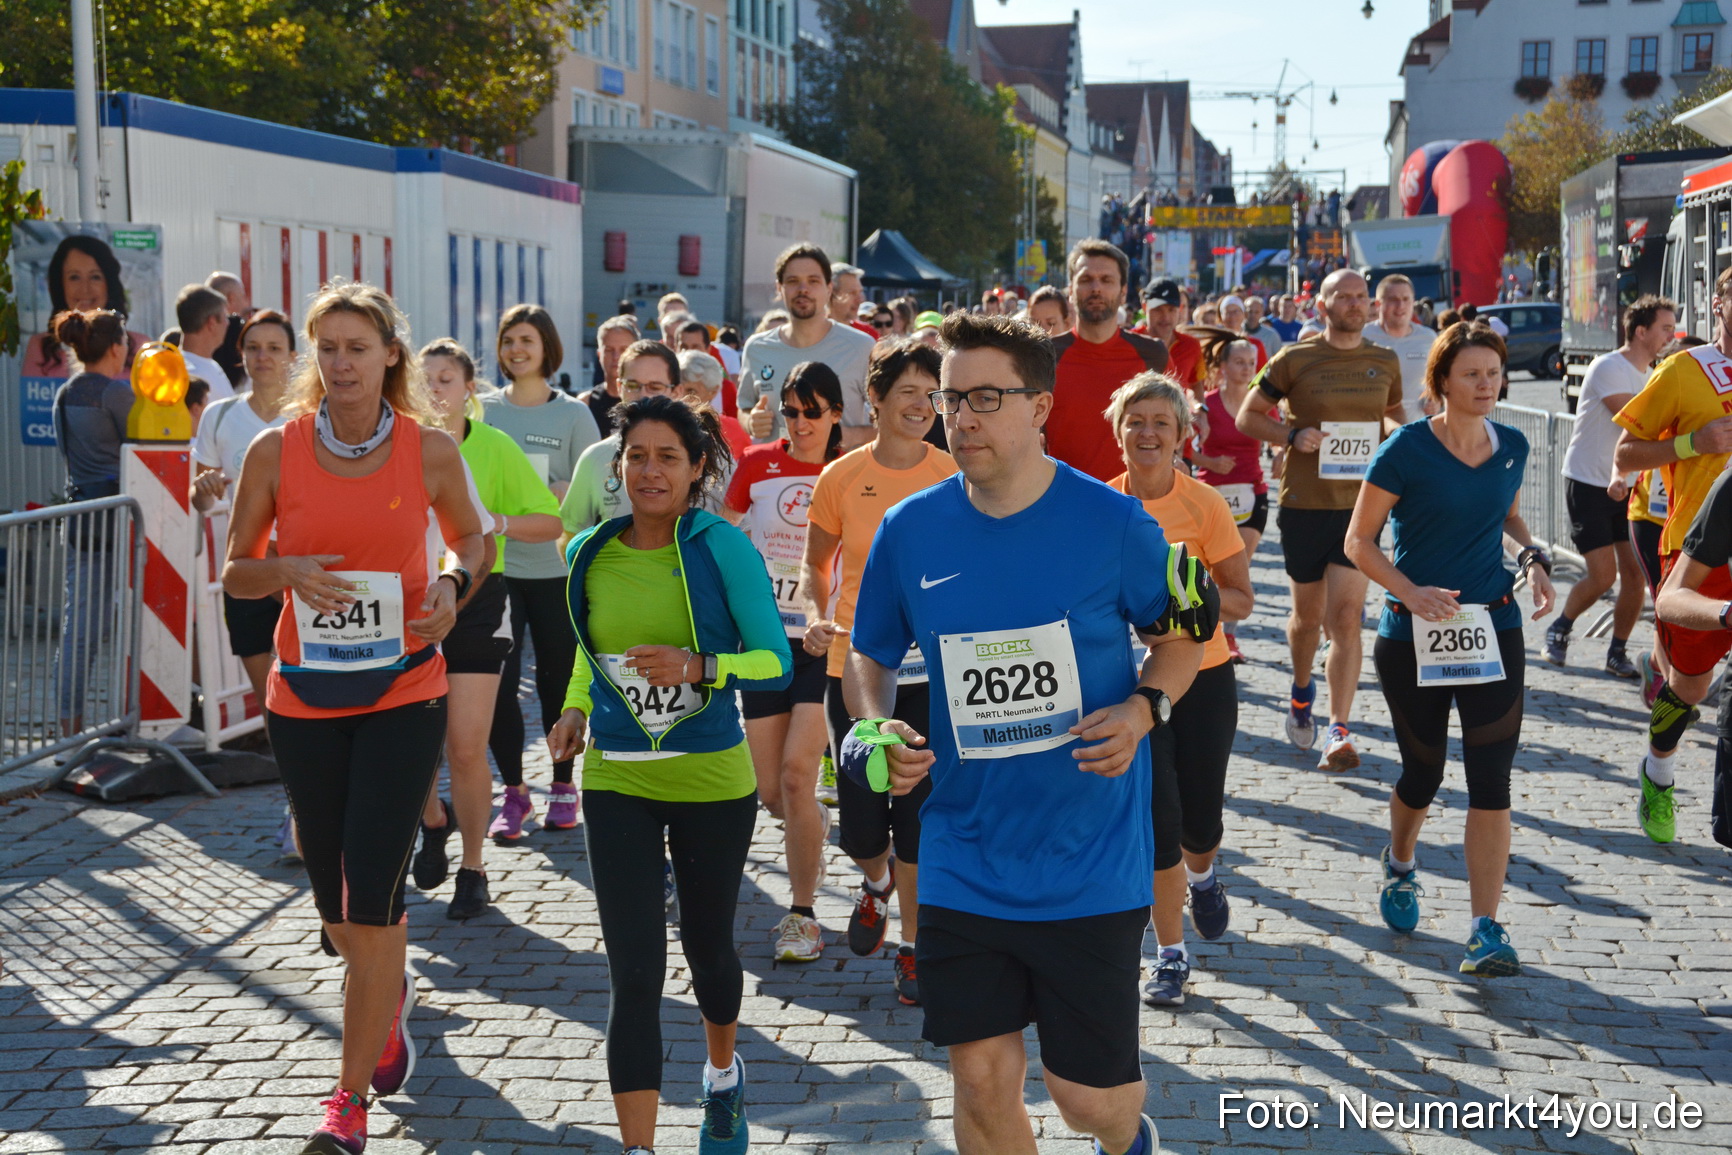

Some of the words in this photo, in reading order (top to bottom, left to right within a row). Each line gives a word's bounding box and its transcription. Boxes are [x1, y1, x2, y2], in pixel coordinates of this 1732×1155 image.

[526, 434, 561, 446] BOCK
[1330, 438, 1370, 456] 2075
[769, 577, 800, 602] 17
[312, 599, 381, 630] 2341
[976, 639, 1034, 657] BOCK
[1427, 626, 1487, 653] 2366
[328, 646, 374, 660] Monika
[1442, 665, 1481, 677] Martina
[963, 661, 1059, 706] 2628
[616, 685, 686, 718] 342
[954, 699, 960, 707] D
[975, 709, 1003, 720] PARTL
[1004, 706, 1043, 717] Neumarkt
[983, 723, 1053, 744] Matthias
